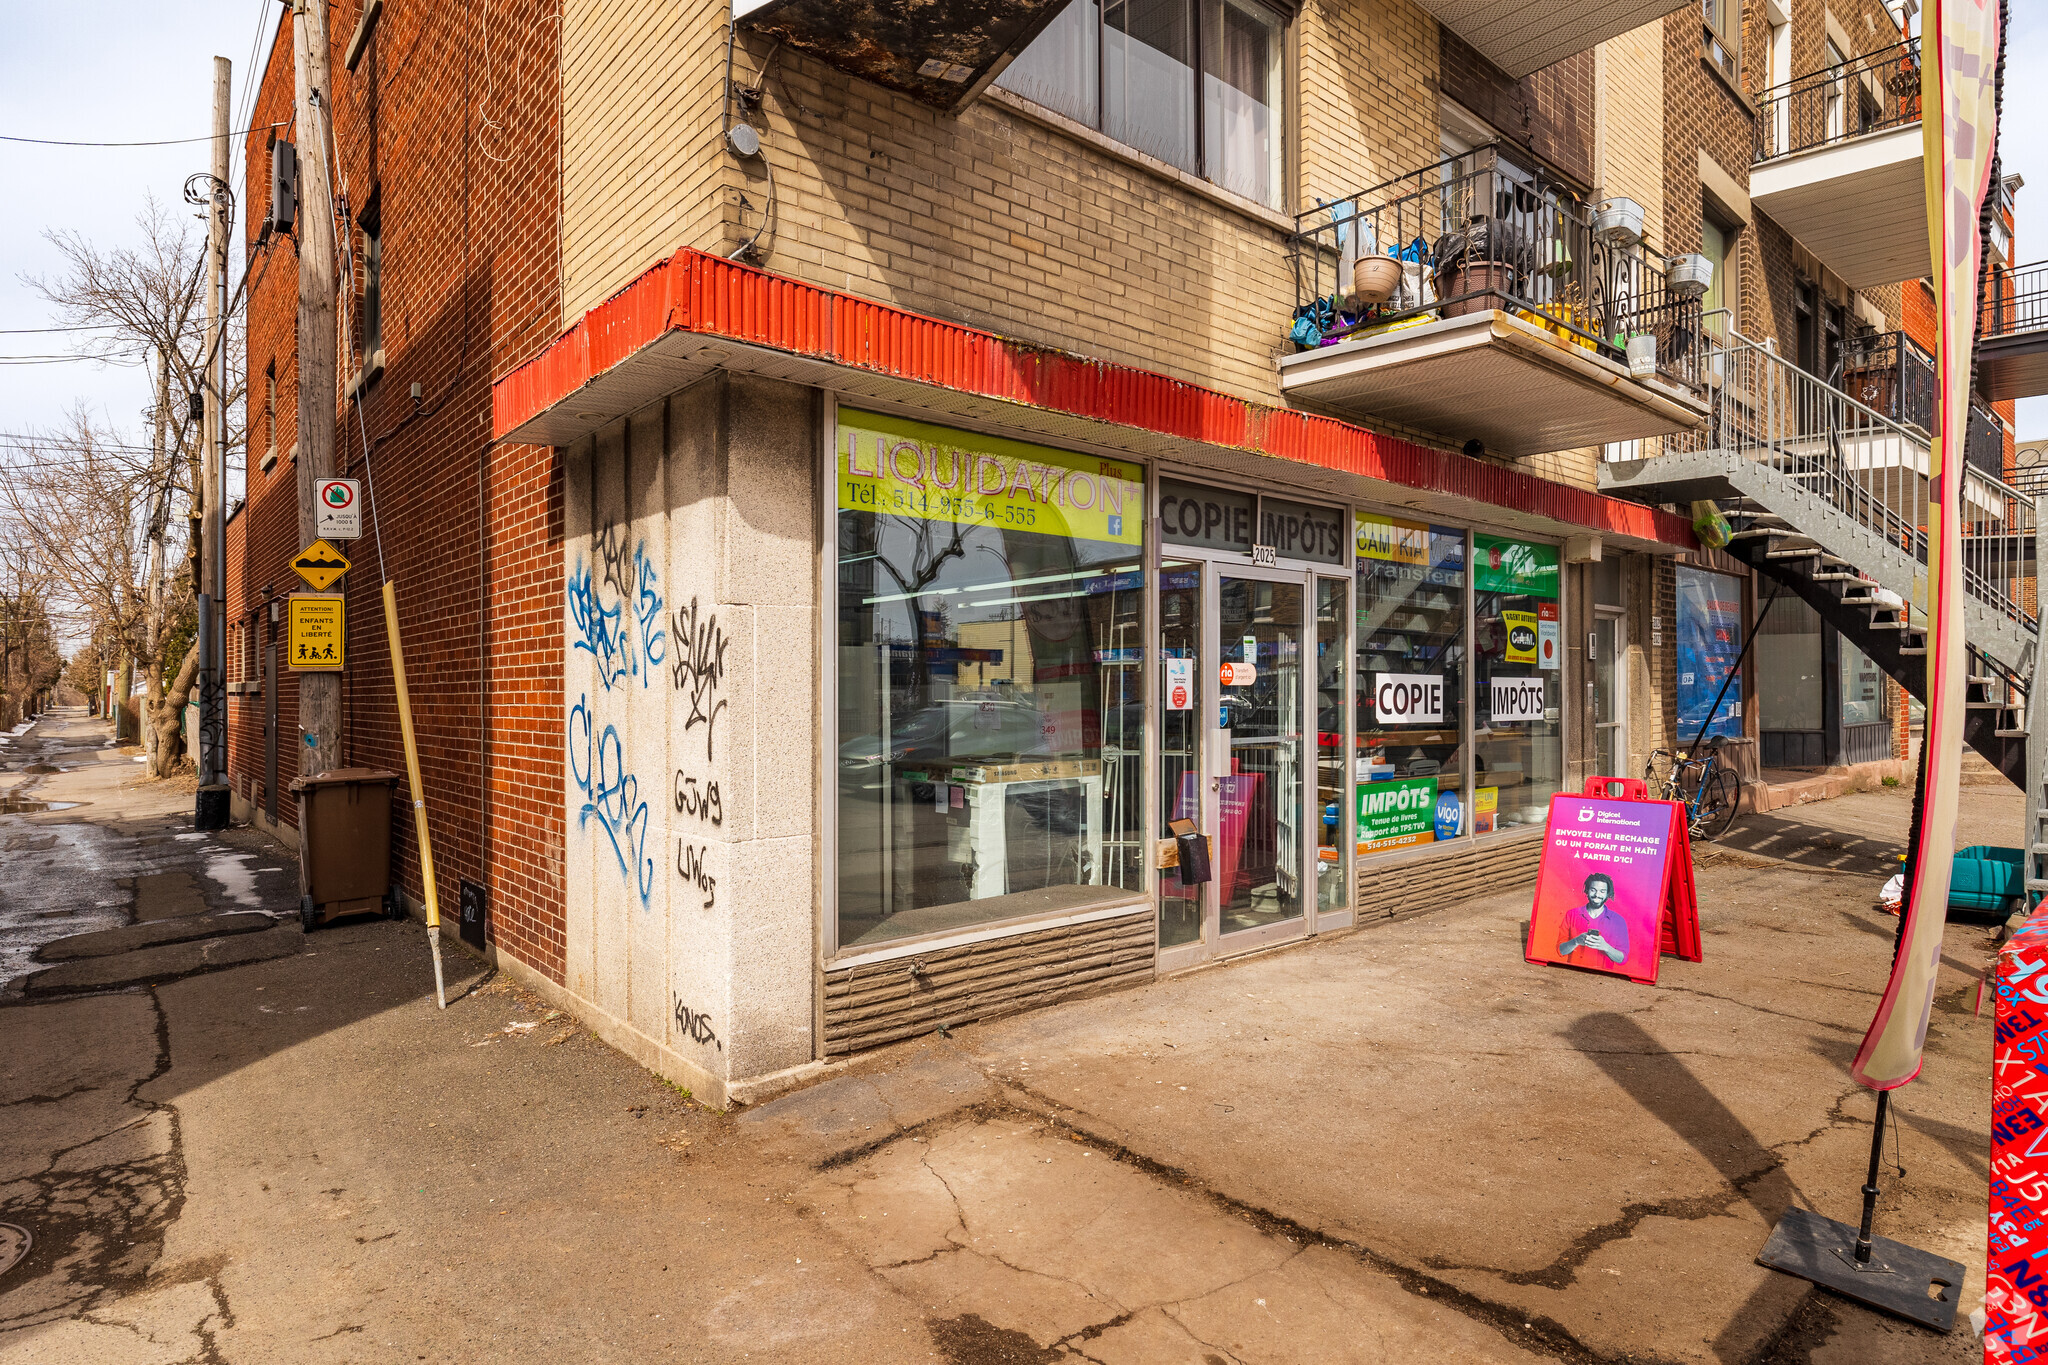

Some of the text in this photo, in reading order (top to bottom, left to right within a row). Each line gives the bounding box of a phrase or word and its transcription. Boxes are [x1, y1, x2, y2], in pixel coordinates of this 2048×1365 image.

[1099, 461, 1122, 479] Plus
[893, 488, 1036, 526] 514-955-6-555
[1160, 496, 1249, 544] COPIE
[1261, 512, 1339, 557] IMPÔTS
[1357, 530, 1389, 553] CAM
[1255, 547, 1274, 564] 2025
[1400, 537, 1423, 559] RIA
[1374, 564, 1462, 586] ransfert
[1541, 608, 1549, 618] ria
[1221, 666, 1232, 677] ria
[1379, 683, 1441, 715] COPIE
[1493, 681, 1543, 715] IMPÔTS
[1041, 726, 1056, 735] 349
[1361, 784, 1430, 816] IMPÔTS
[1372, 817, 1390, 825] Tenue
[1438, 803, 1458, 823] vigo
[1597, 810, 1621, 819] Digicel
[1597, 818, 1640, 826] International
[1361, 829, 1389, 838] Rapport
[1400, 822, 1425, 832] TPS/TVQ
[1556, 829, 1660, 844] ENVOYEZ UNE RECHARGE
[1367, 836, 1417, 850] 514-515-4232
[1570, 840, 1582, 848] UN
[1584, 842, 1618, 852] FORFAIT
[1620, 845, 1632, 853] EN
[1634, 846, 1657, 855] HAÏTI
[1574, 850, 1633, 864] À PARTIR D'ICI
[2004, 1170, 2048, 1216] J5
[2003, 1259, 2048, 1319] N8
